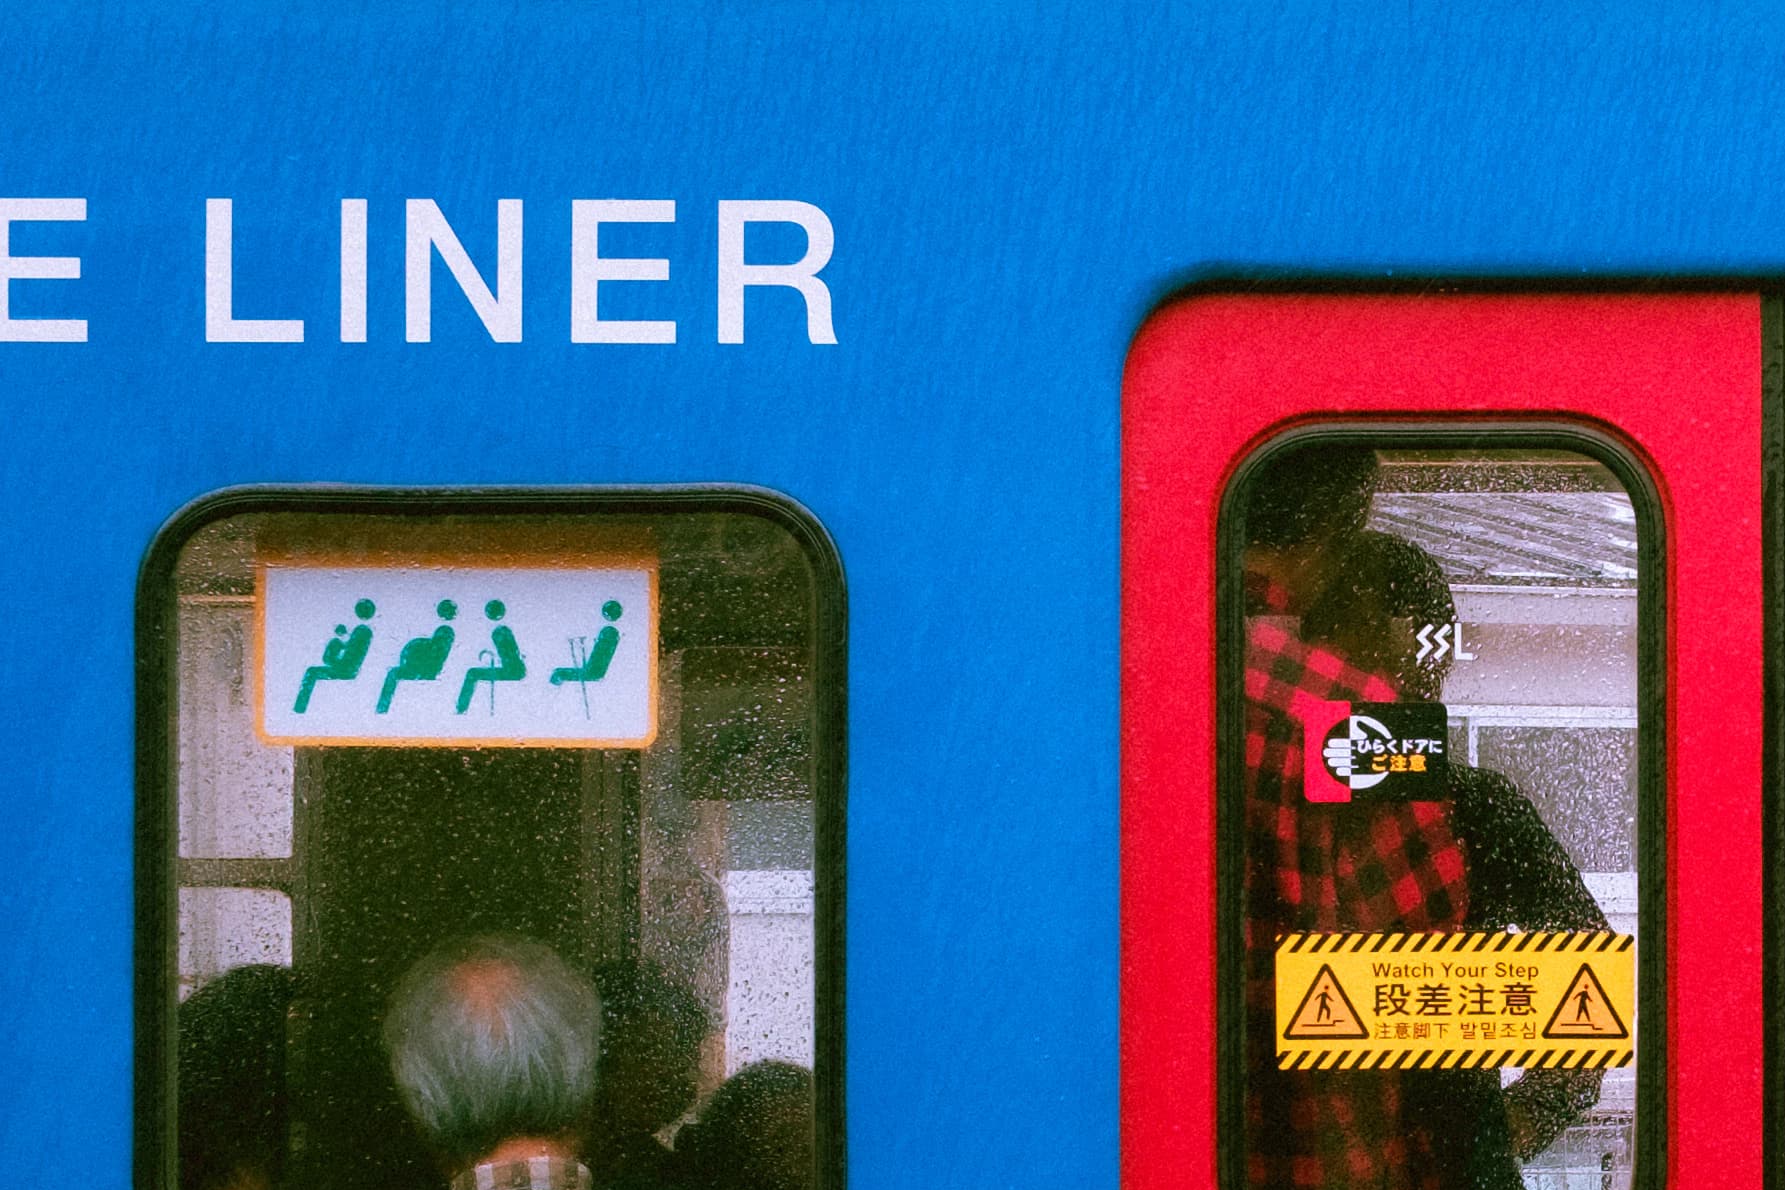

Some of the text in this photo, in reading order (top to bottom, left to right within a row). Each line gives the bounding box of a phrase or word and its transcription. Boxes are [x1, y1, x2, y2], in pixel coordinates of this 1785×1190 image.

[205, 198, 838, 344] LINER
[1416, 623, 1473, 662] SSL
[1356, 739, 1443, 754] ひらくドアに
[1371, 754, 1427, 772] ご注意
[1372, 962, 1539, 980] Watch Your Step
[1373, 982, 1538, 1017] 段差注意
[1374, 1022, 1537, 1040] 注意脚下 발밑조심
